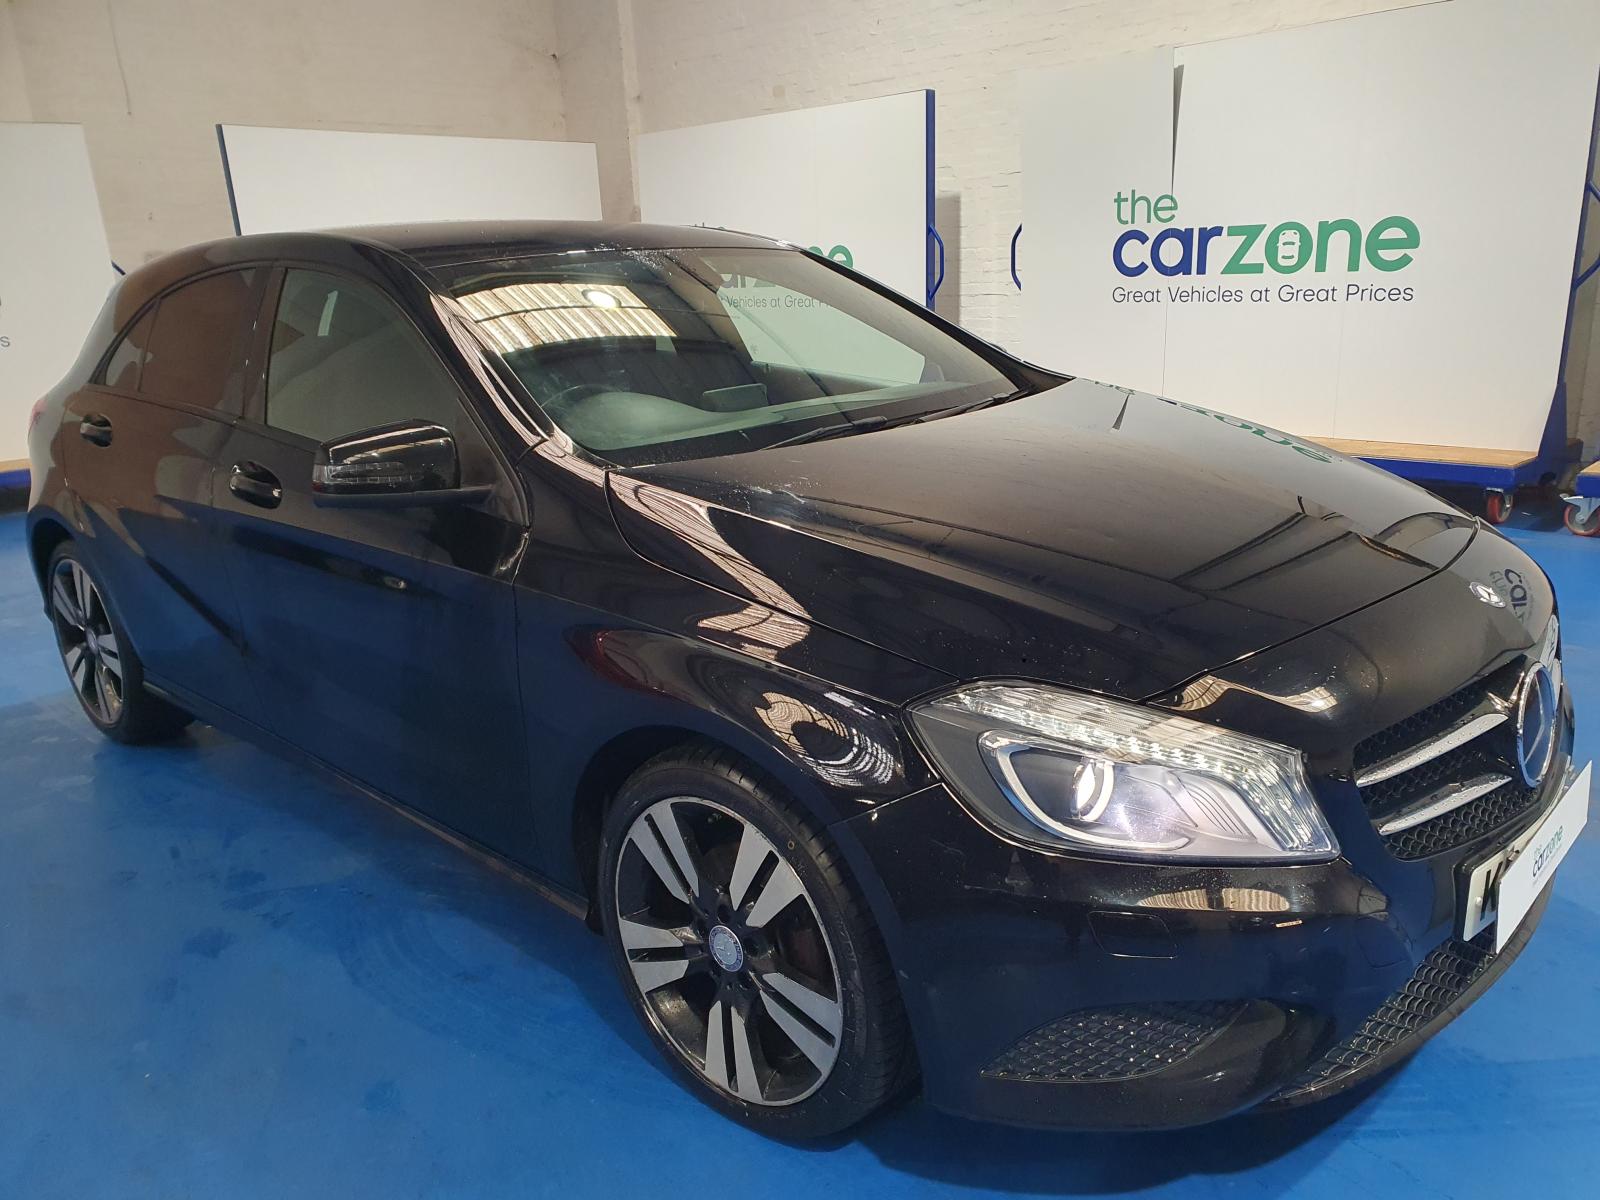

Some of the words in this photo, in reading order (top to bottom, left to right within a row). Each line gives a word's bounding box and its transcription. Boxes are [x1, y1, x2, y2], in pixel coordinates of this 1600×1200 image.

[1113, 189, 1179, 225] the
[1112, 215, 1421, 278] carzone
[784, 294, 816, 308] Great
[1112, 286, 1161, 303] Great
[1168, 285, 1244, 303] Vehicles
[1250, 286, 1271, 302] at
[1278, 284, 1338, 302] Great
[1346, 283, 1414, 302] Prices
